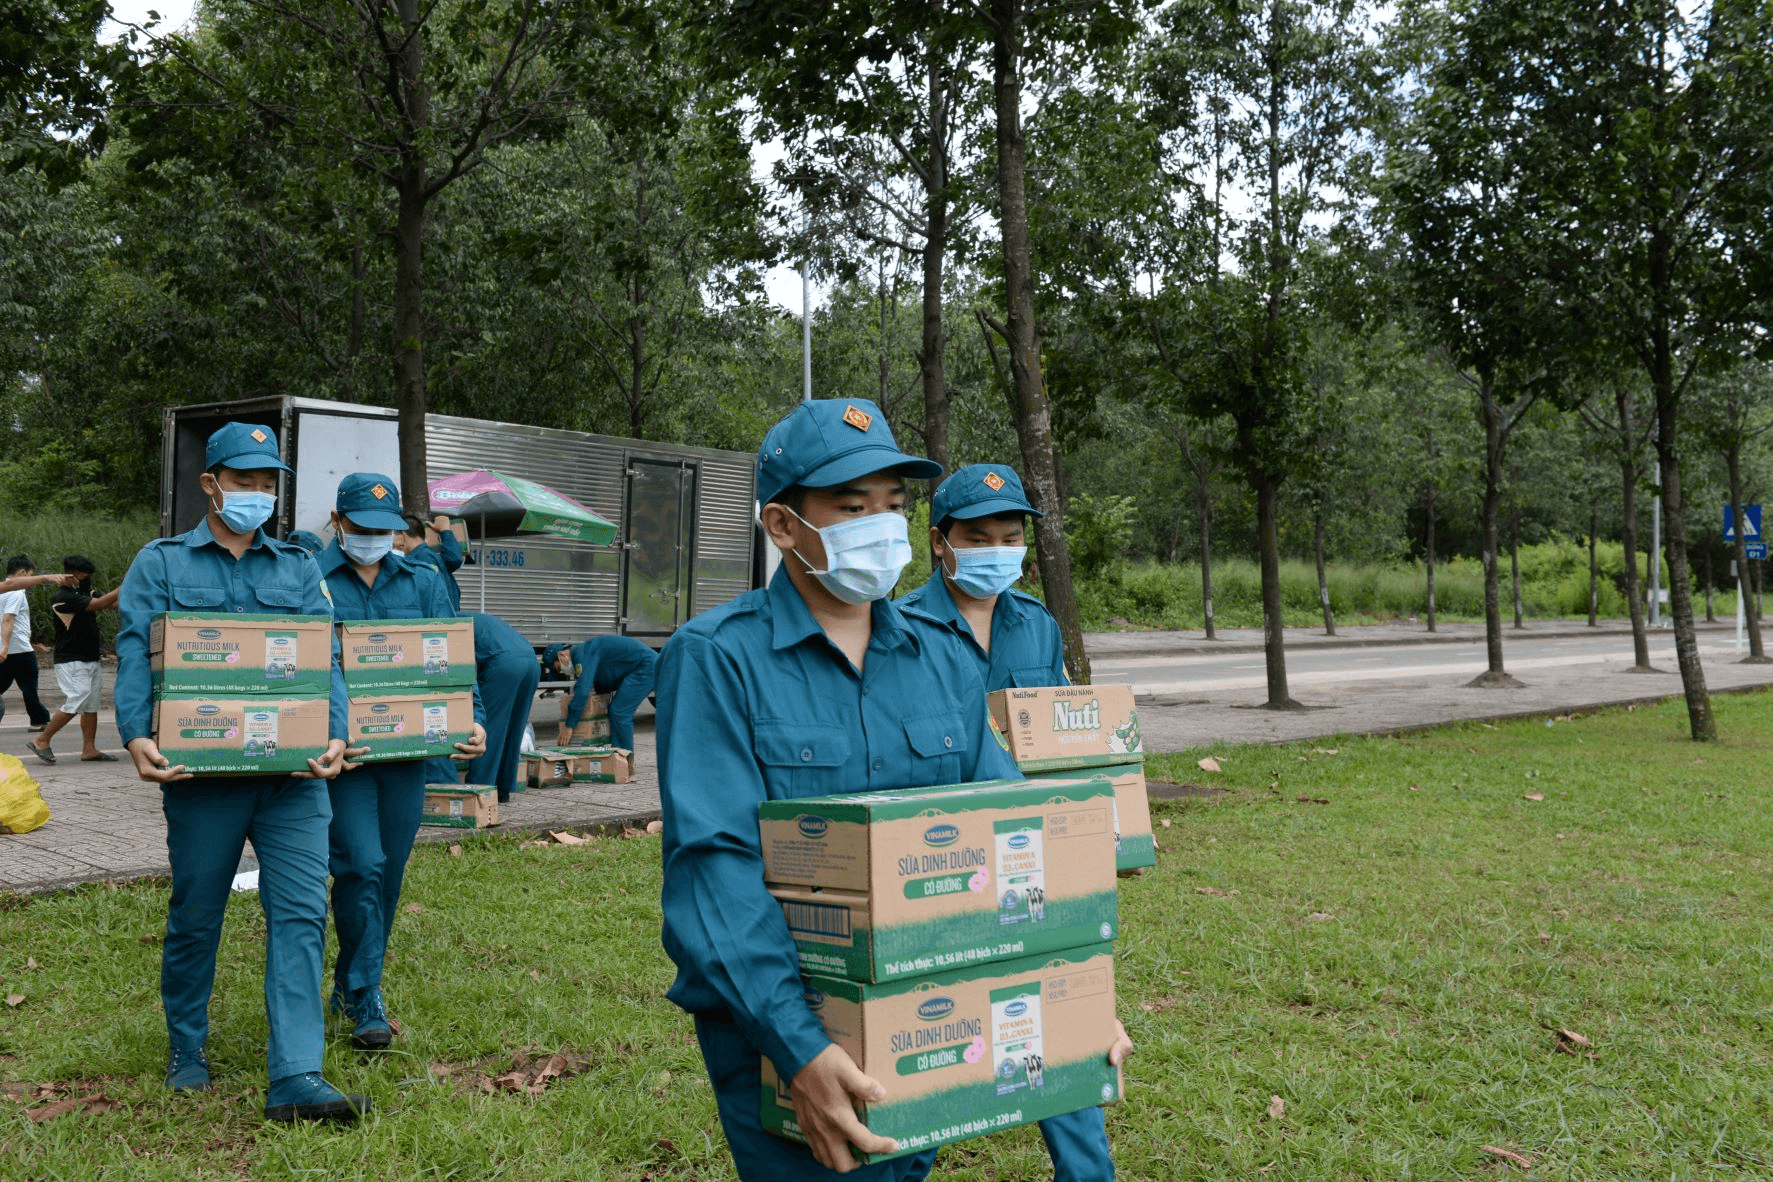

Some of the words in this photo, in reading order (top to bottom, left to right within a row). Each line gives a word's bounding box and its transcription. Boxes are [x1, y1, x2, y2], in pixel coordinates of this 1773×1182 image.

[176, 641, 221, 651] NUTRITIOUS
[222, 642, 240, 651] MILK
[352, 645, 388, 654] NUTRITIOUS
[388, 644, 403, 652] MILK
[192, 653, 222, 661] SWEETENED
[193, 717, 212, 727] DINH
[356, 715, 390, 724] NUTRITIOUS
[390, 714, 405, 723] MILK
[1052, 698, 1102, 732] Nuti
[925, 828, 959, 840] VINAMILK
[898, 854, 920, 877] SỮA
[922, 852, 948, 873] DINH
[950, 847, 986, 870] DƯỠNG
[924, 879, 935, 896] CÓ
[936, 876, 962, 894] ĐƯỜNG
[884, 961, 900, 975] Thể
[900, 959, 914, 973] tích
[914, 957, 934, 971] thực:
[955, 951, 964, 962] lít
[964, 948, 976, 962] (48
[976, 946, 991, 960] bịch
[998, 943, 1011, 955] 220
[1011, 940, 1024, 953] ml)
[920, 1002, 953, 1014] VINAMILK
[890, 1030, 913, 1053] SỮA
[915, 1026, 942, 1048] DINH
[944, 1018, 982, 1042] DƯỠNG
[917, 1053, 928, 1070] CÓ
[929, 1049, 957, 1068] ĐƯỜNG
[897, 1137, 909, 1150] ích
[909, 1134, 930, 1148] thực:
[951, 1125, 960, 1137] lít
[960, 1121, 973, 1136] (48
[973, 1117, 989, 1132] bịch
[996, 1113, 1010, 1126] 220
[1010, 1109, 1023, 1123] ml)
